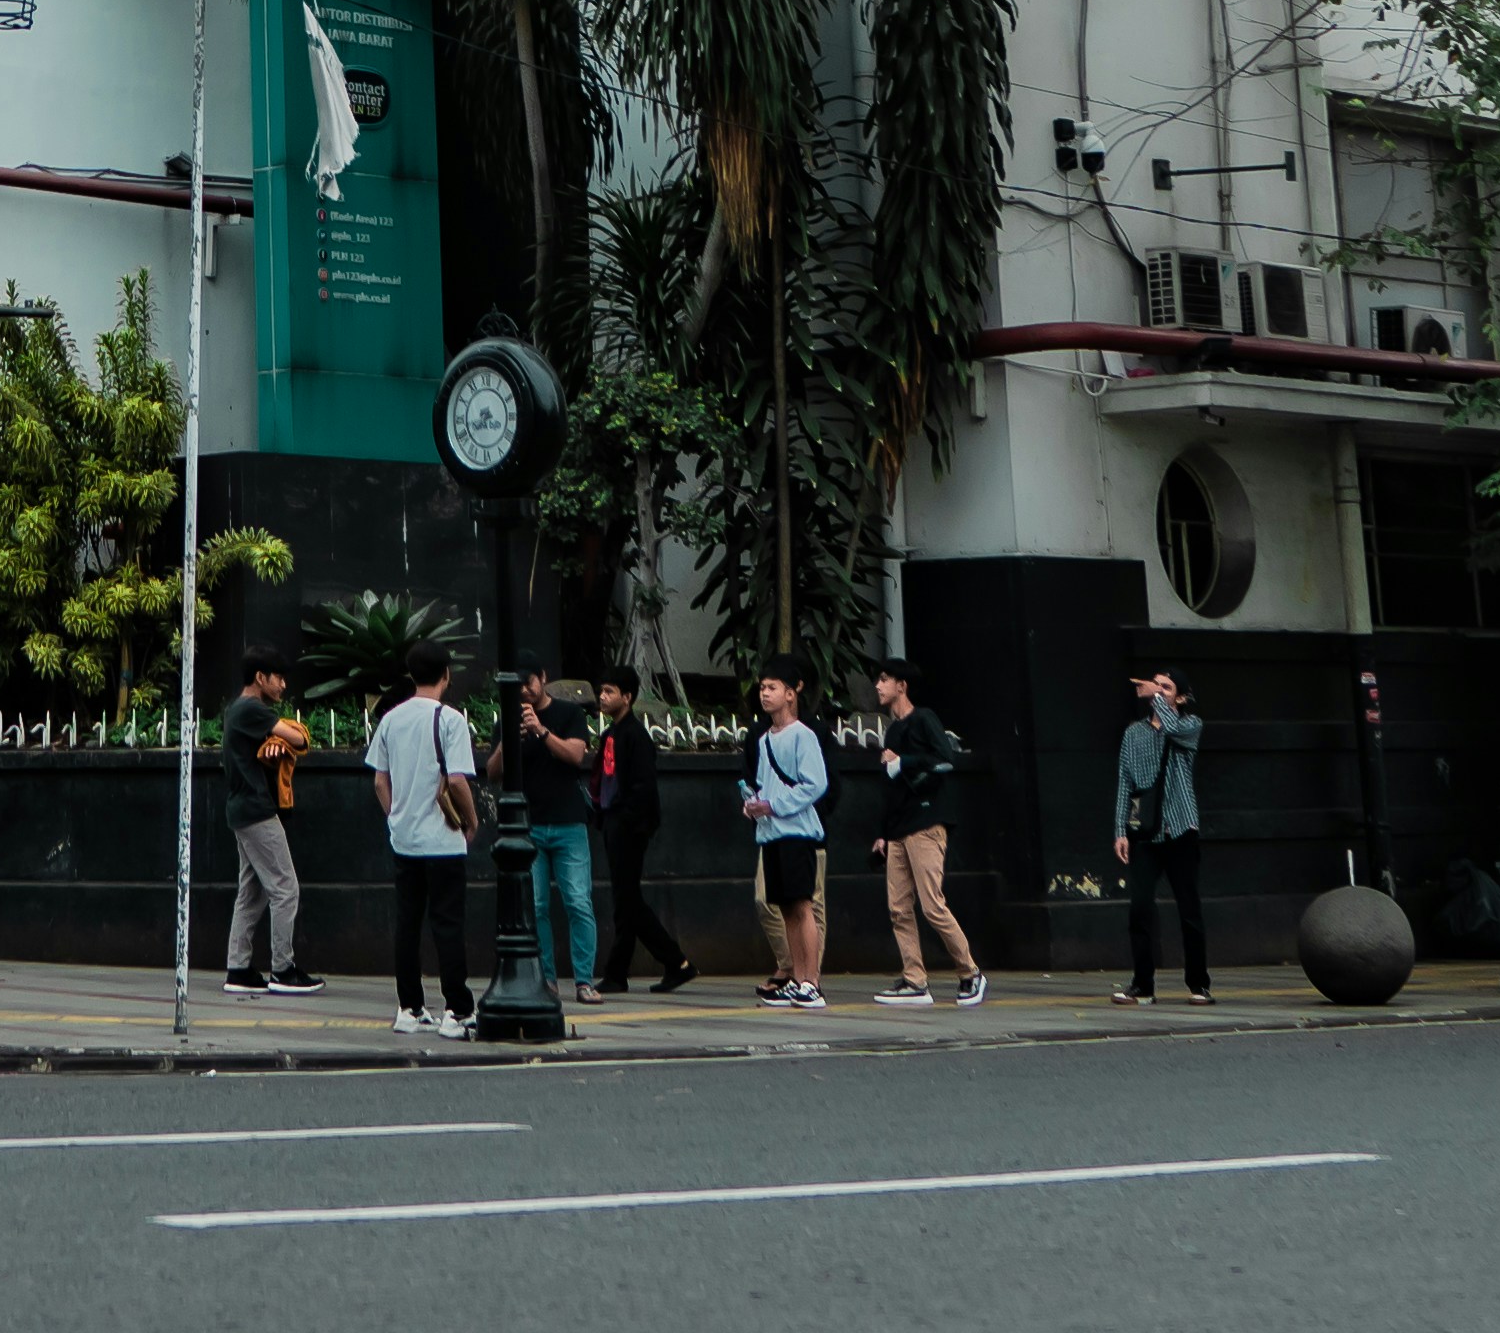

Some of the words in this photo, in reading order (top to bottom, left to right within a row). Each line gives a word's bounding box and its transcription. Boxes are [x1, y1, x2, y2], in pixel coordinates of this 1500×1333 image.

[353, 11, 413, 32] DISTRIBUSI
[358, 32, 395, 49] BARAT
[346, 81, 386, 97] ontact
[350, 93, 384, 108] enter
[379, 216, 394, 227] 123
[331, 250, 349, 262] PLN
[350, 252, 365, 263] 123
